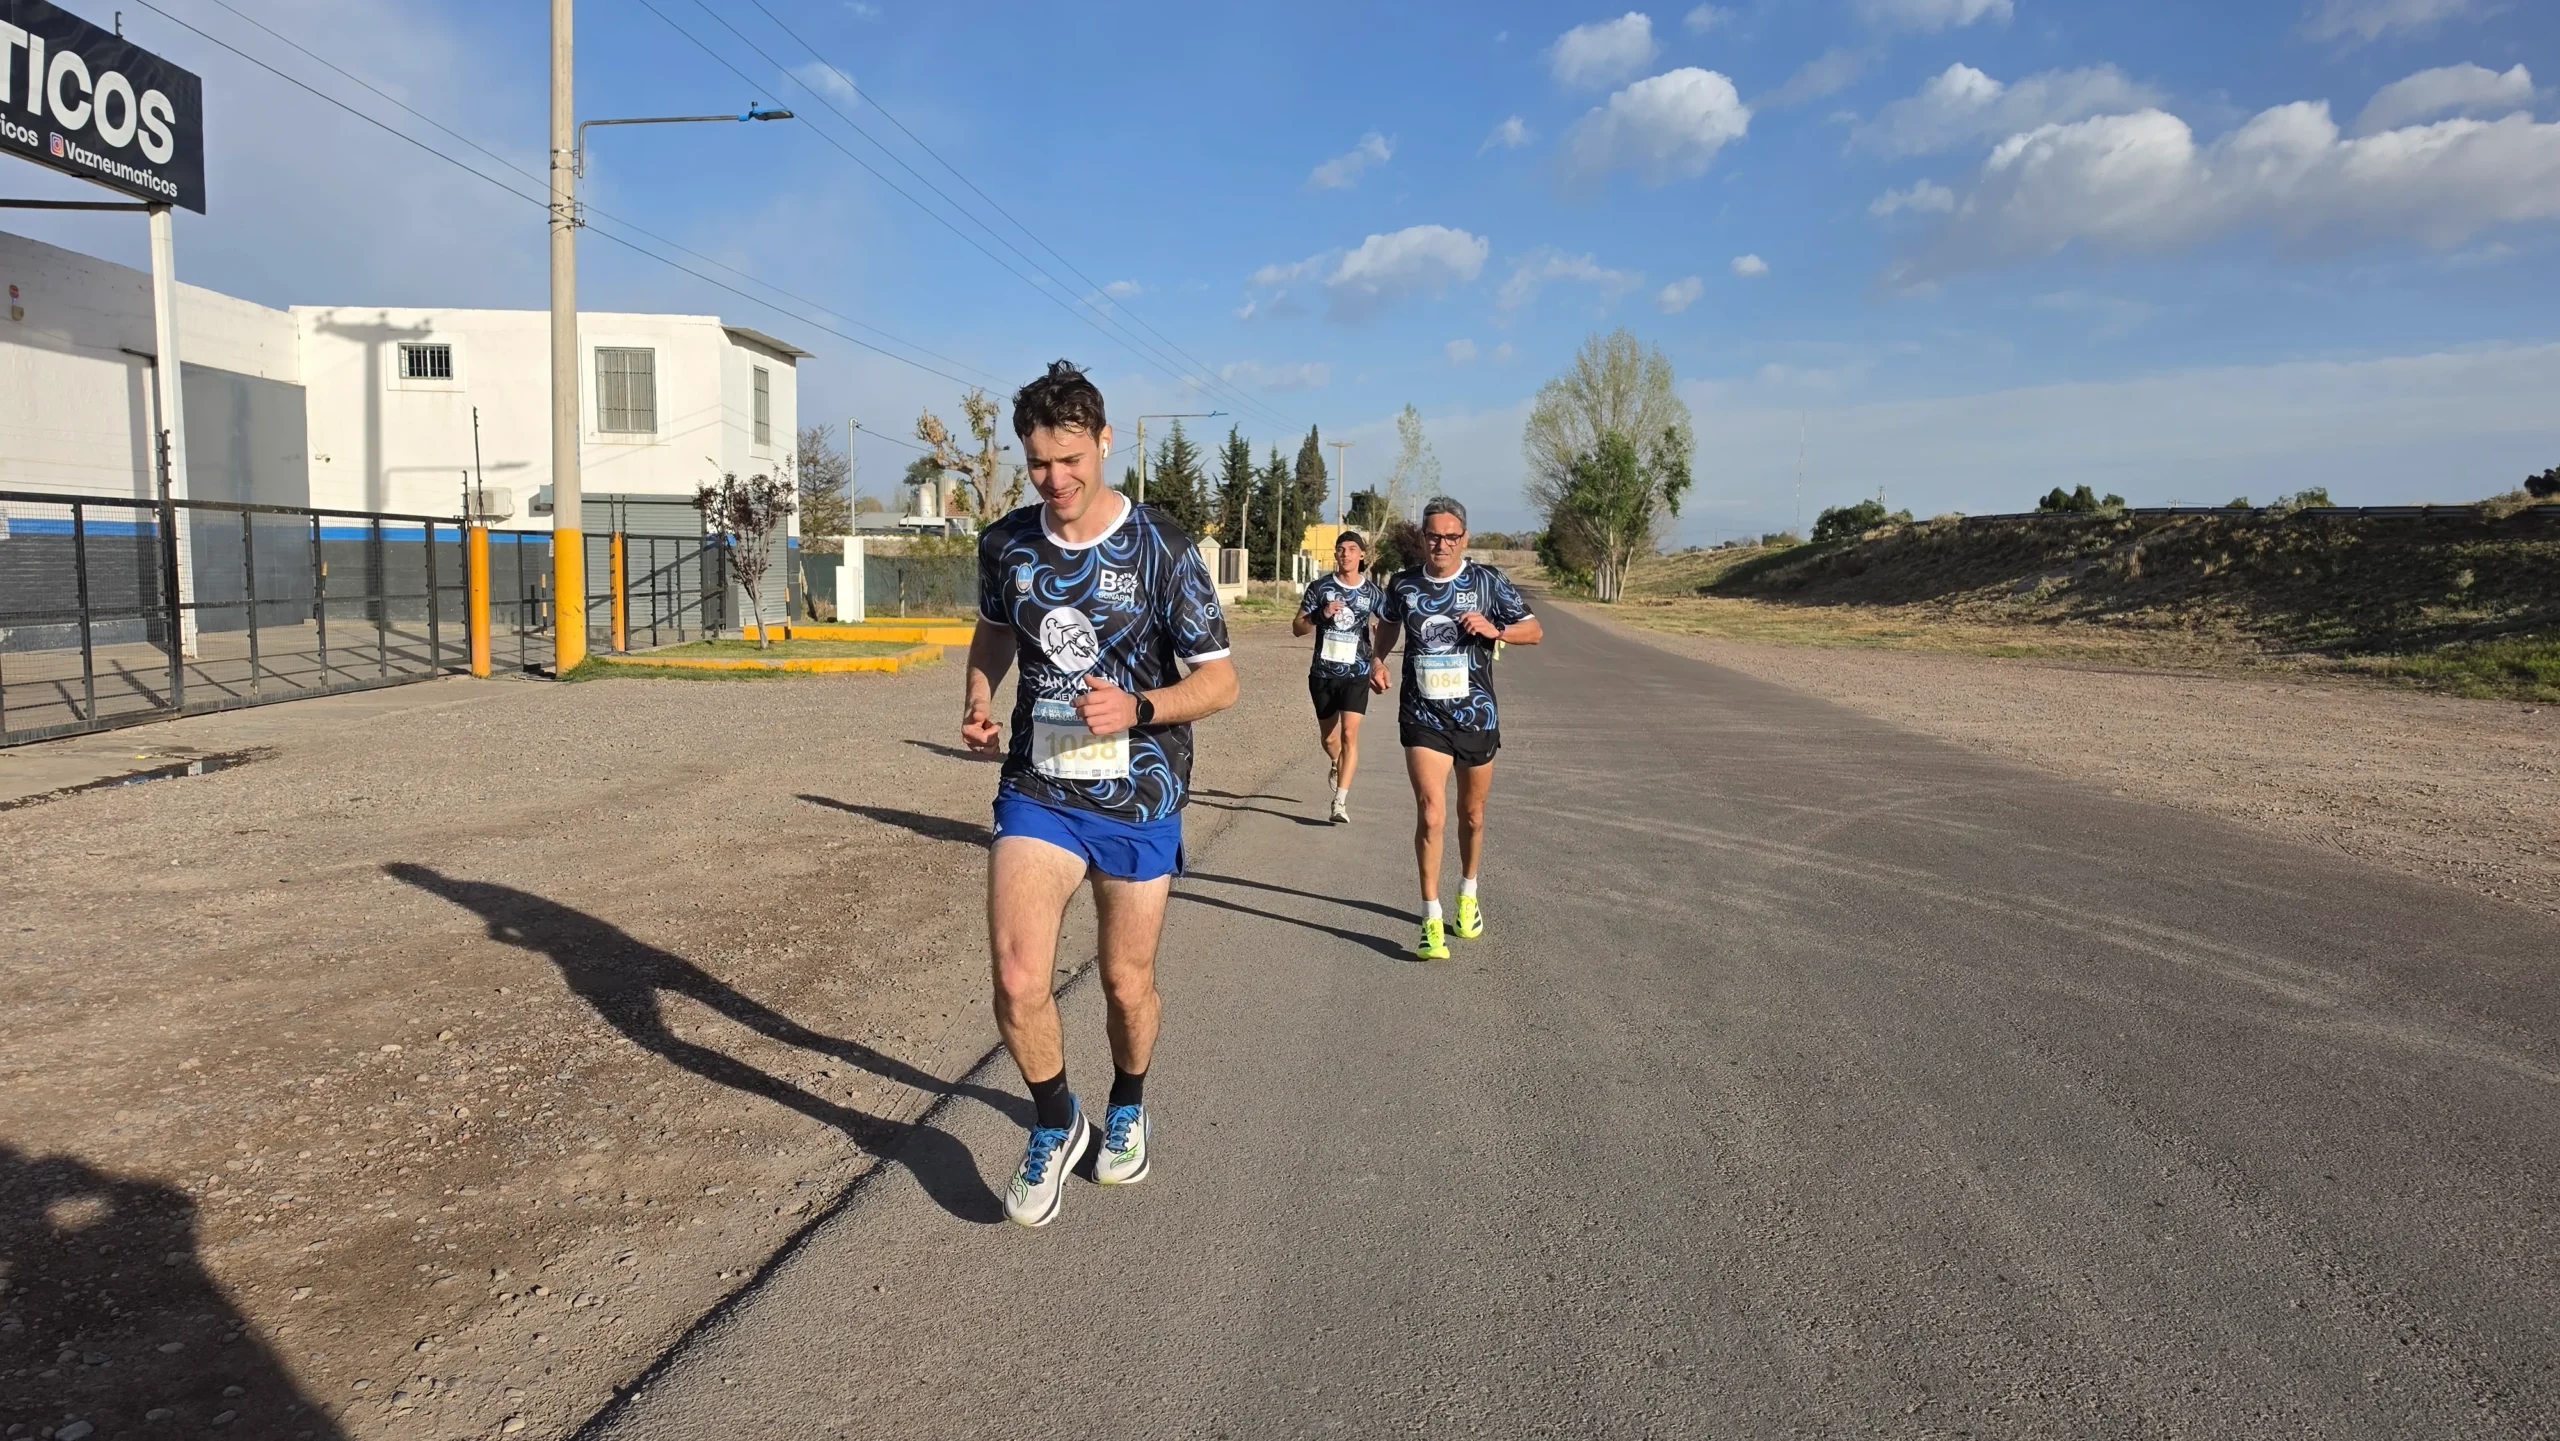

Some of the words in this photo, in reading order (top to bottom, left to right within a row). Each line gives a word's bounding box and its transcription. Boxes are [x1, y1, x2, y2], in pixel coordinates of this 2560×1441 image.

[0, 113, 39, 147] icos
[65, 139, 178, 198] Vazneumaticos
[1039, 674, 1063, 689] SAN
[1045, 731, 1117, 761] 1058
